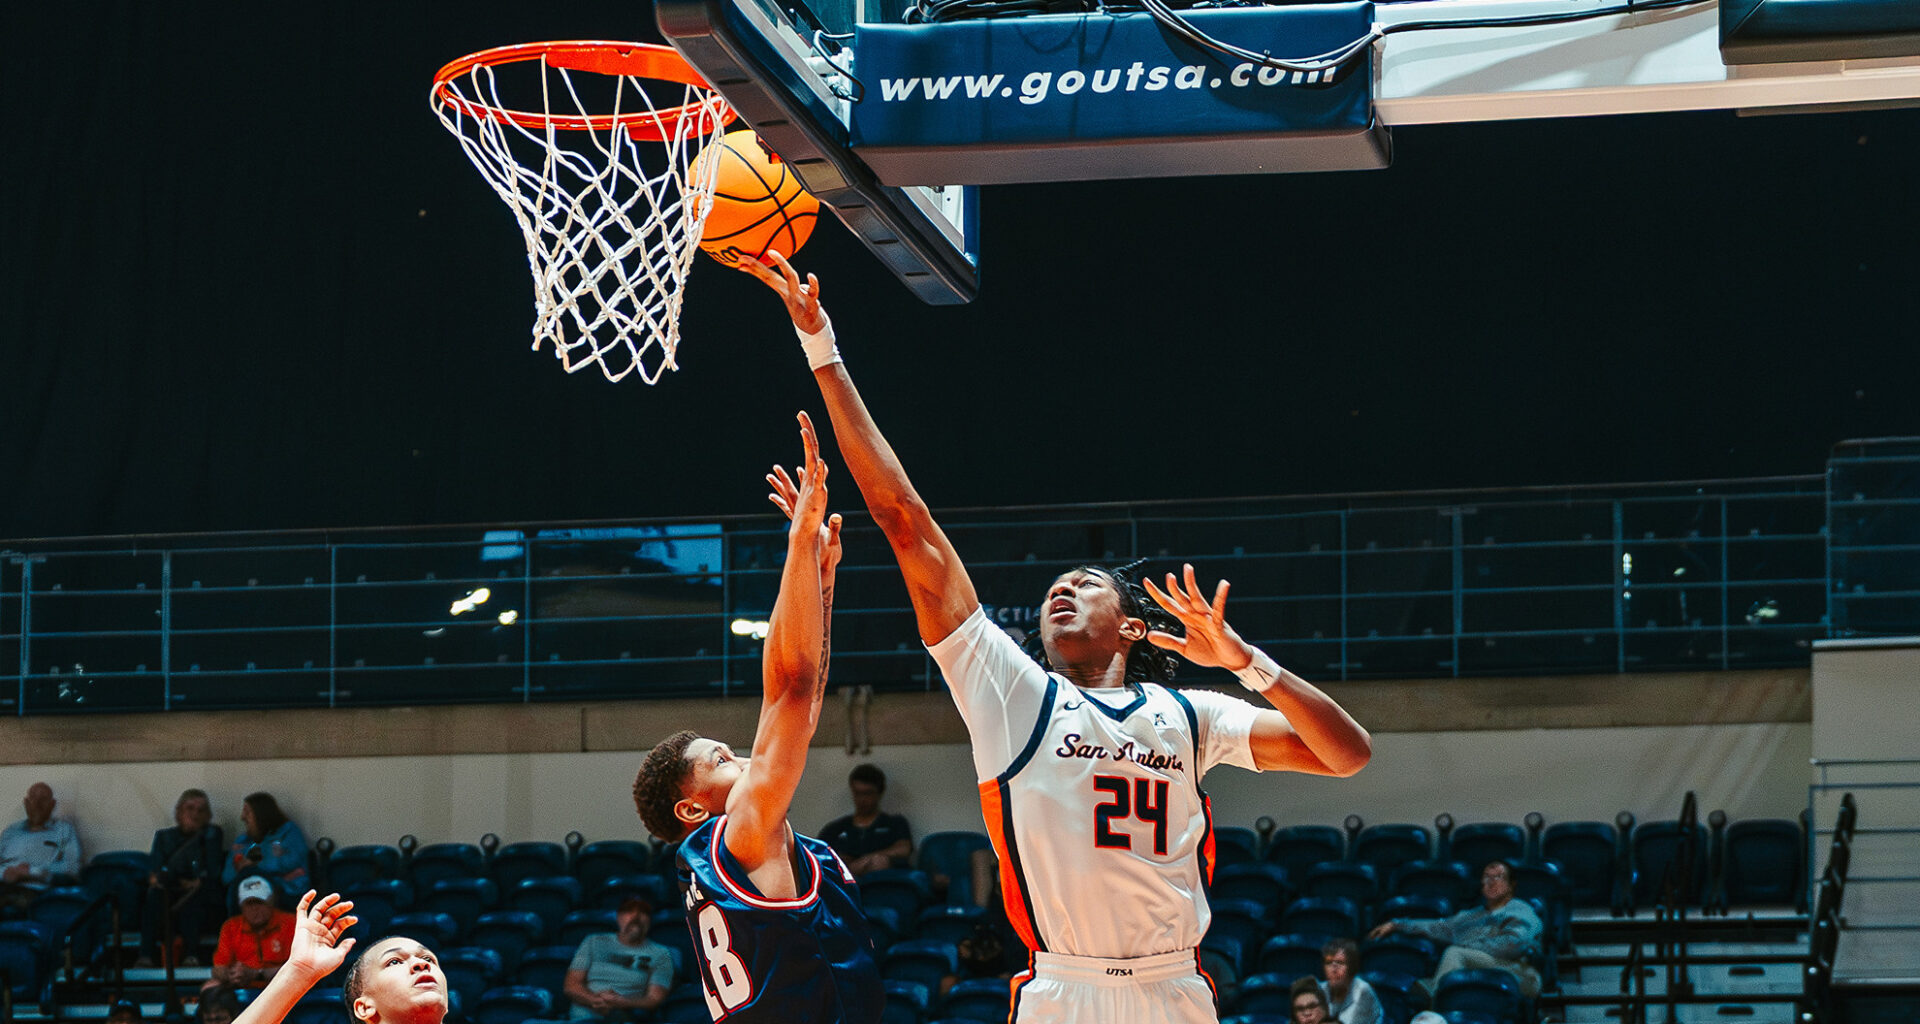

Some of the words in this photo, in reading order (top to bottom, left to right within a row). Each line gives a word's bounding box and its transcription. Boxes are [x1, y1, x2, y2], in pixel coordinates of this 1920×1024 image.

[879, 58, 1338, 105] www.goutsa.com
[1055, 733, 1108, 759] San
[1093, 774, 1170, 856] 24
[1105, 967, 1134, 976] UTSA
